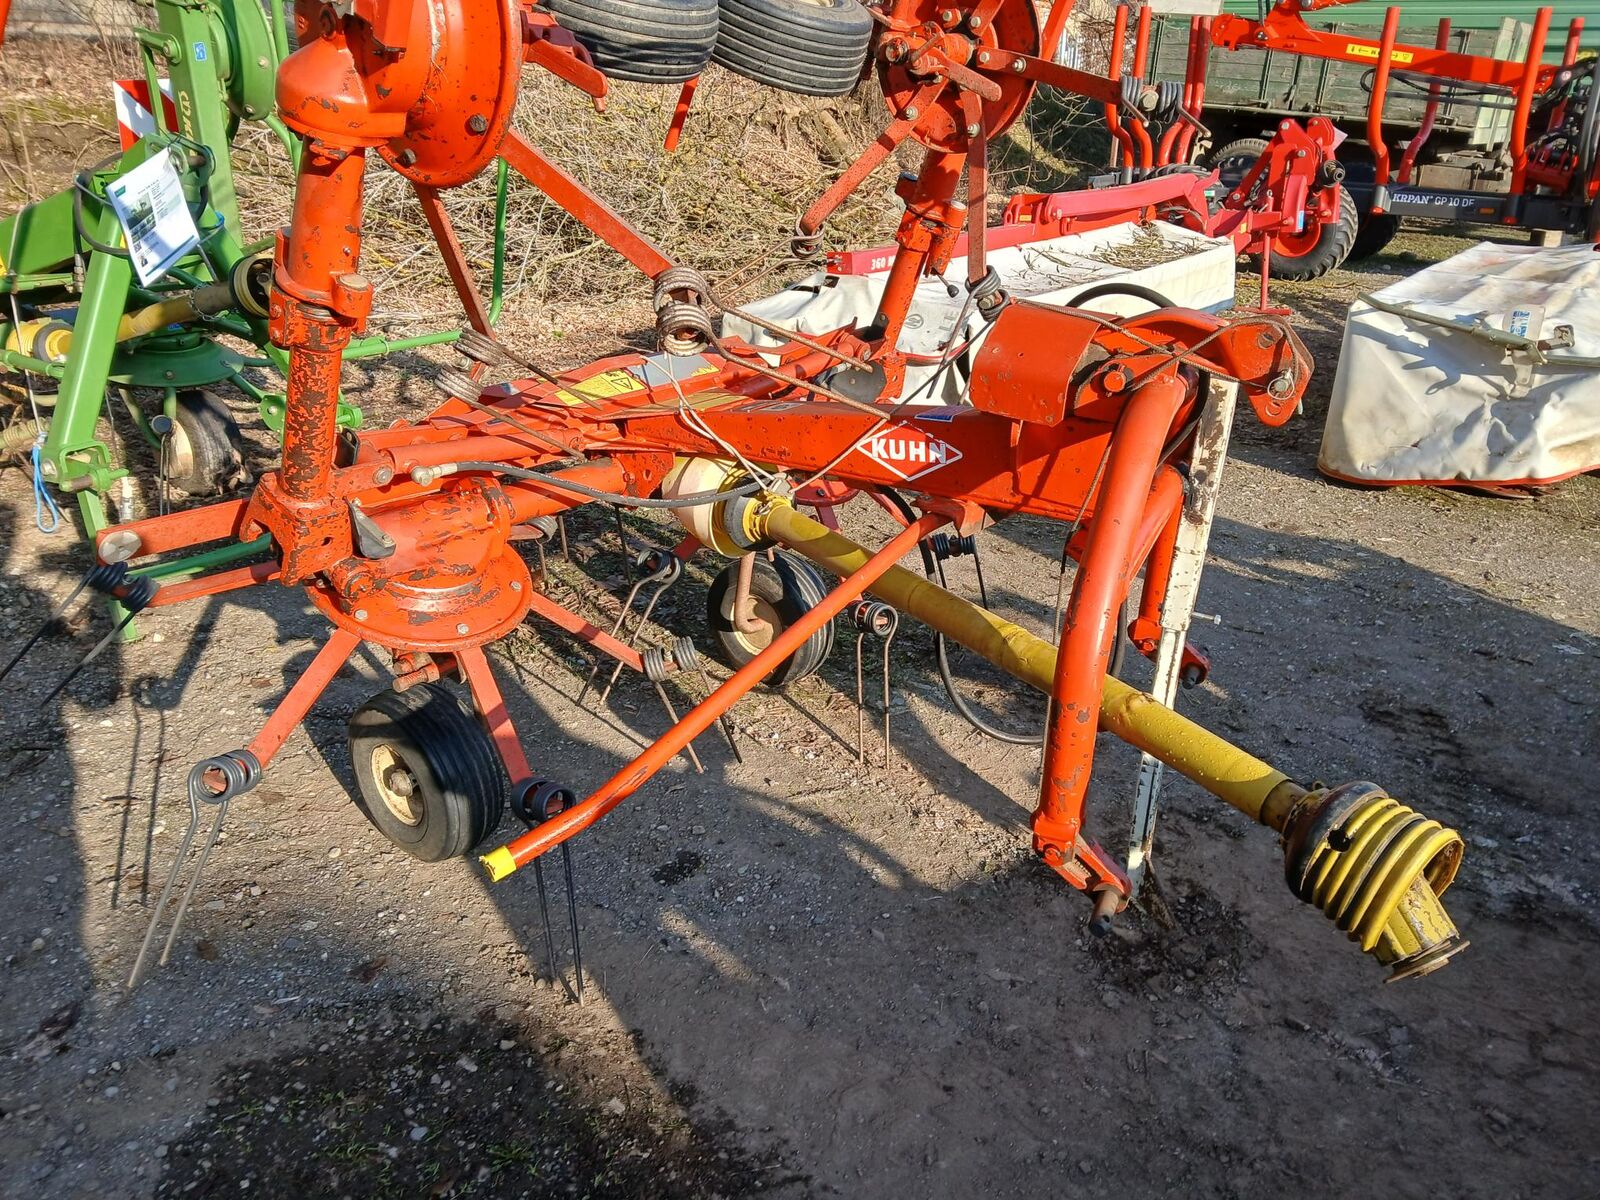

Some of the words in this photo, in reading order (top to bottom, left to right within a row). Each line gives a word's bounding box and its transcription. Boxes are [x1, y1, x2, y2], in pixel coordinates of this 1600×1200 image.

[1392, 193, 1430, 205] KRPAN
[1434, 195, 1448, 206] GP
[1448, 197, 1460, 207] 10
[871, 256, 886, 270] 360
[871, 438, 947, 464] KUHN
